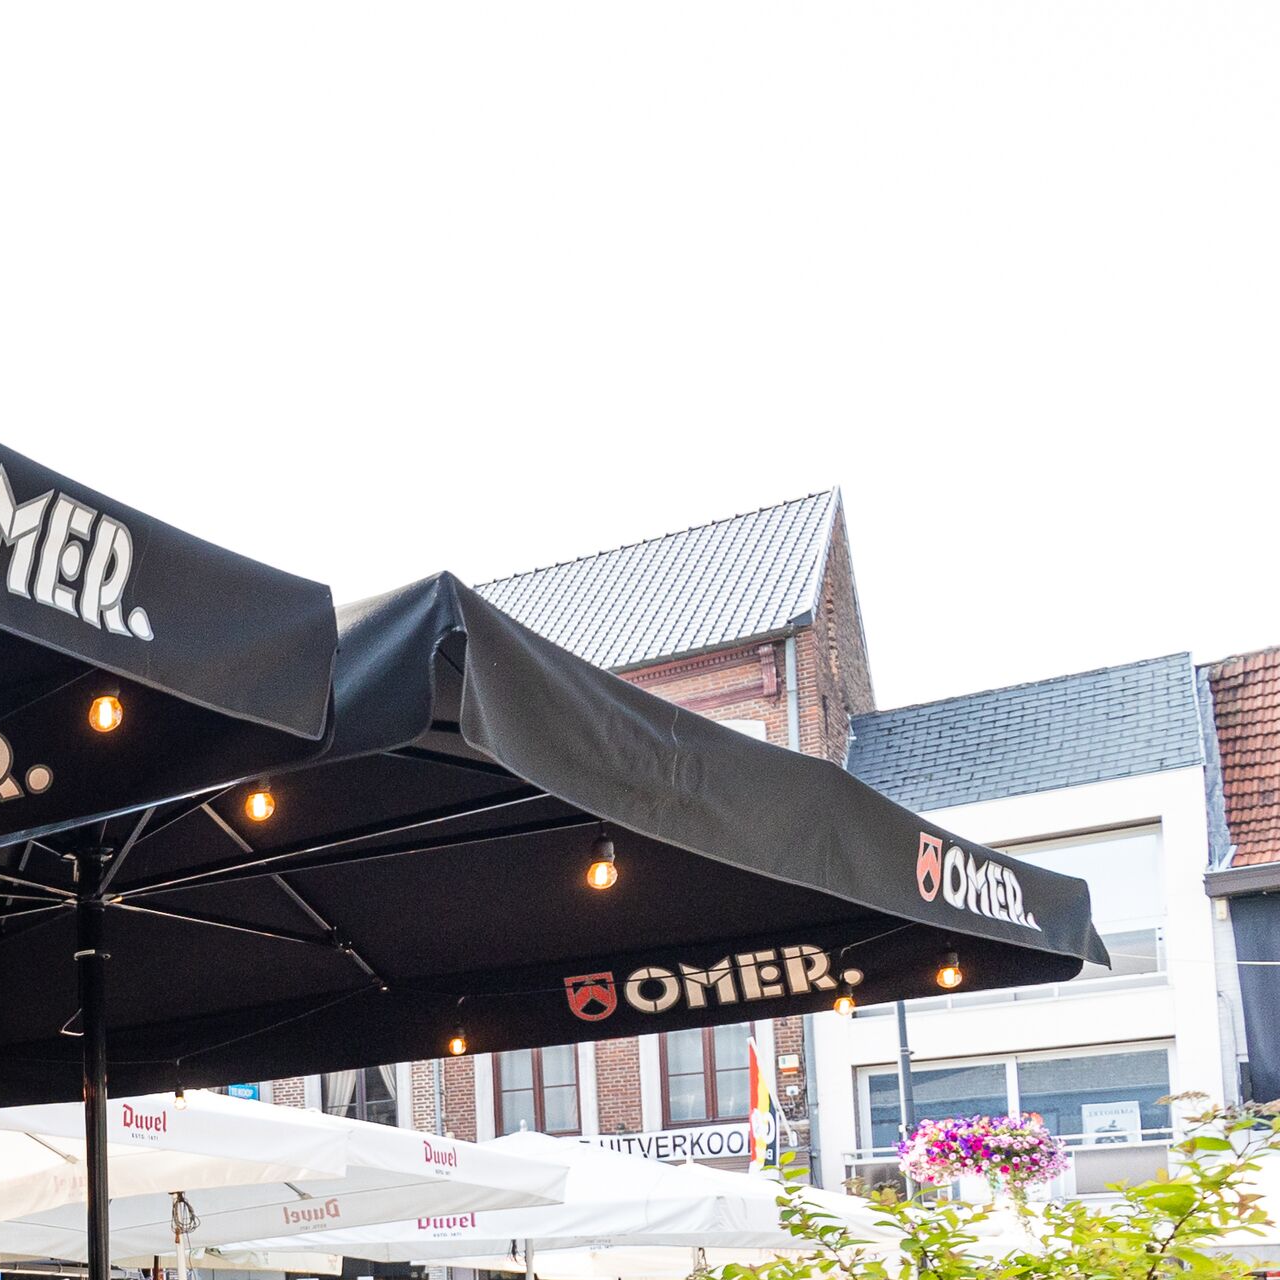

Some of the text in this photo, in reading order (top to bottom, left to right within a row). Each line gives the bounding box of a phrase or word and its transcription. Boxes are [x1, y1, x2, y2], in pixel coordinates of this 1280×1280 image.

[942, 846, 1042, 932] OMER.
[623, 944, 864, 1014] OMER.
[123, 1103, 166, 1133] Duvel
[424, 1140, 457, 1168] Duvel
